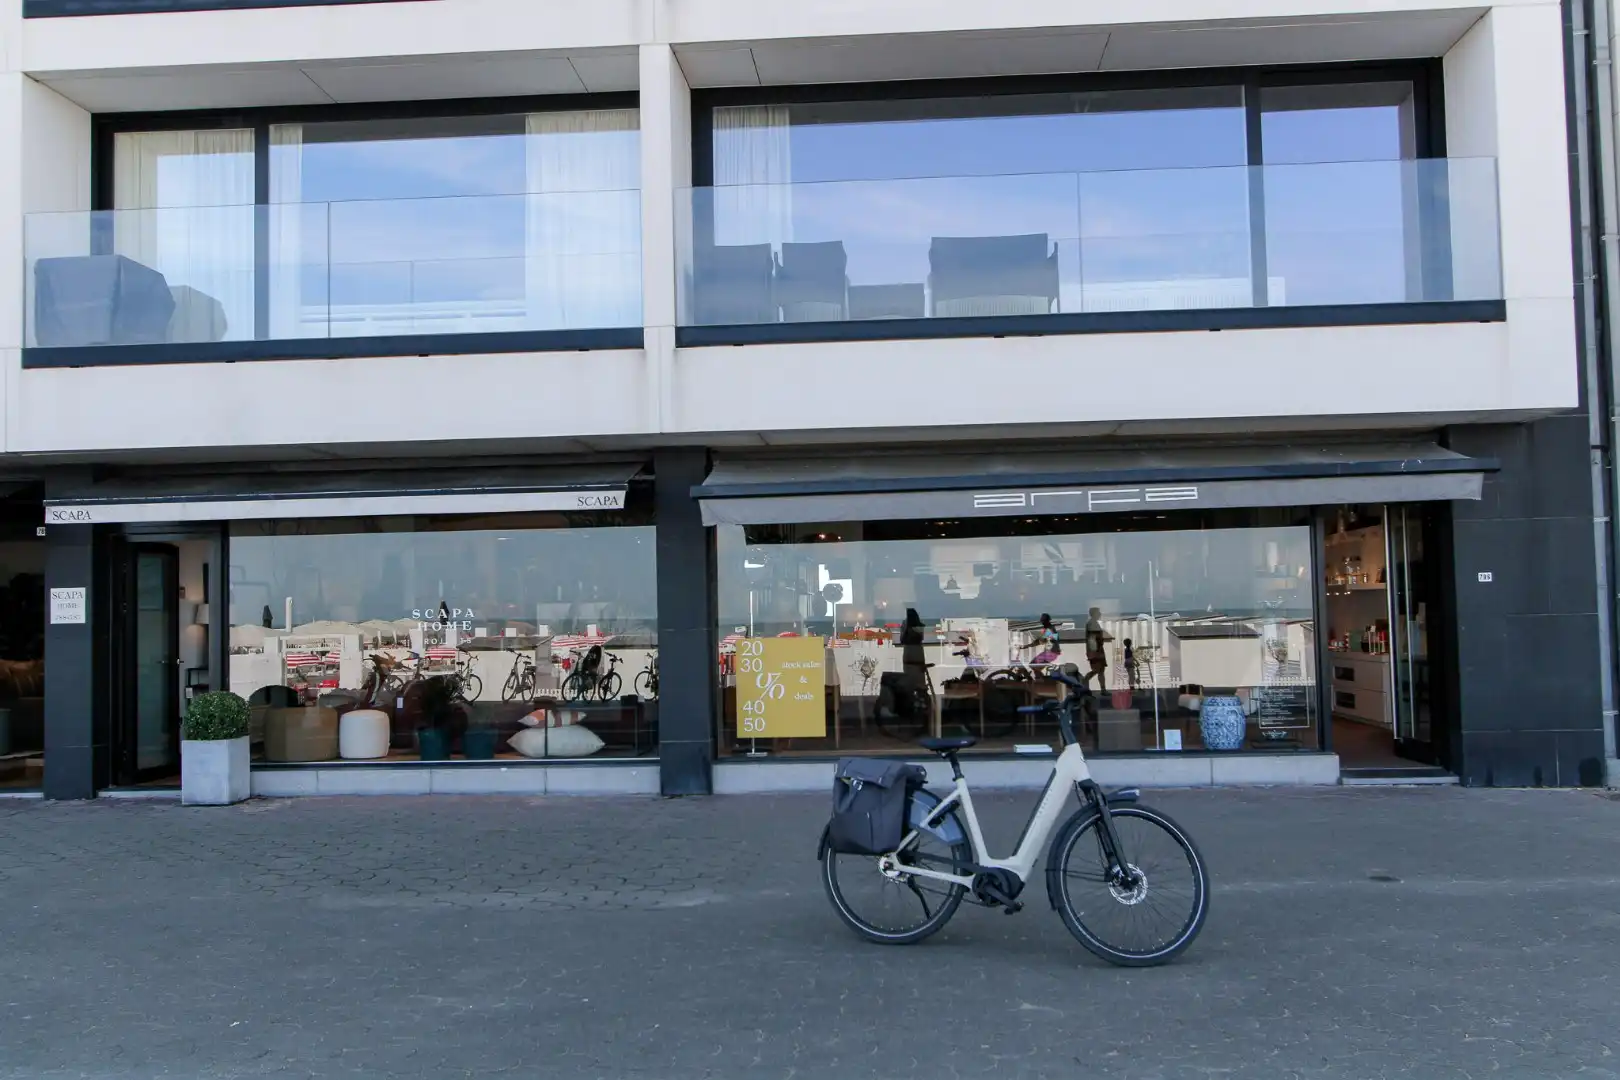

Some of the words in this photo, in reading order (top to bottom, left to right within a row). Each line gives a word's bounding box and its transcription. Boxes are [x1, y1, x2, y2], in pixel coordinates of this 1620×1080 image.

[577, 495, 619, 507] SCAPA
[52, 510, 92, 521] SCAPA
[51, 591, 84, 600] SCAPA
[412, 608, 475, 619] SCAPA
[418, 620, 472, 632] HOME
[741, 640, 763, 656] 20
[740, 658, 763, 673] 30
[742, 700, 765, 715] 40
[743, 717, 766, 732] 50
